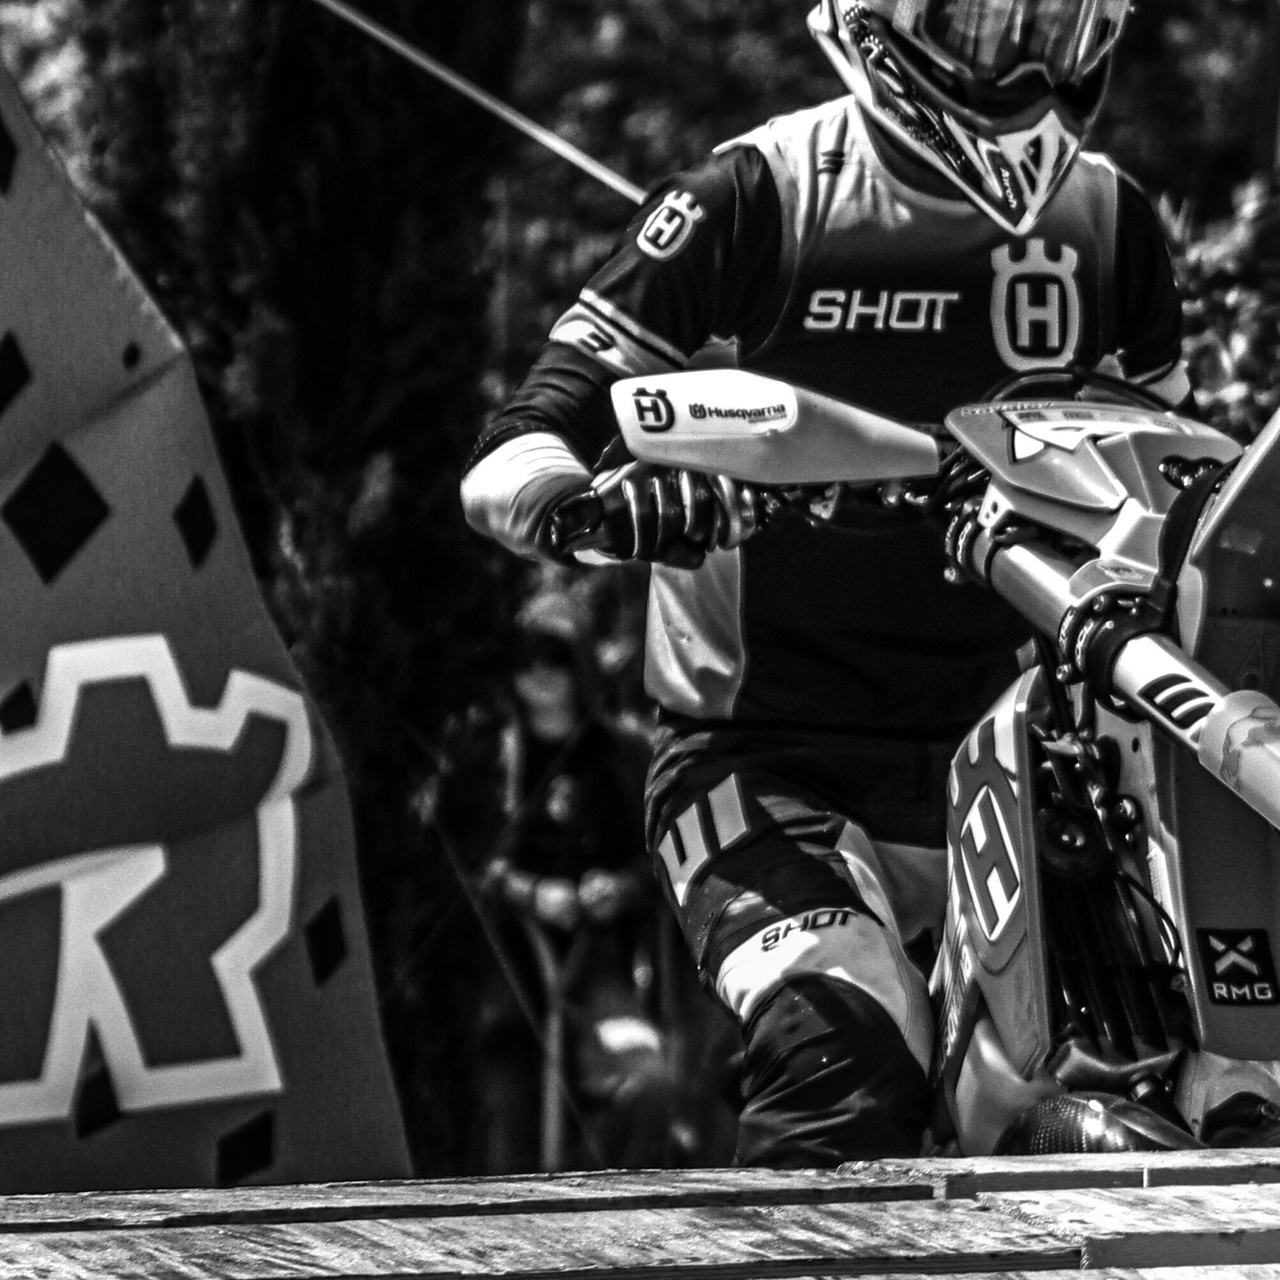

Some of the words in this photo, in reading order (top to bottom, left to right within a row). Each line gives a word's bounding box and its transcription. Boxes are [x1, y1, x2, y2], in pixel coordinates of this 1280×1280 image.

[803, 289, 961, 331] SHOT
[707, 403, 786, 420] Husqvarna
[761, 910, 858, 952] SHOT
[1212, 982, 1273, 1001] RMG
